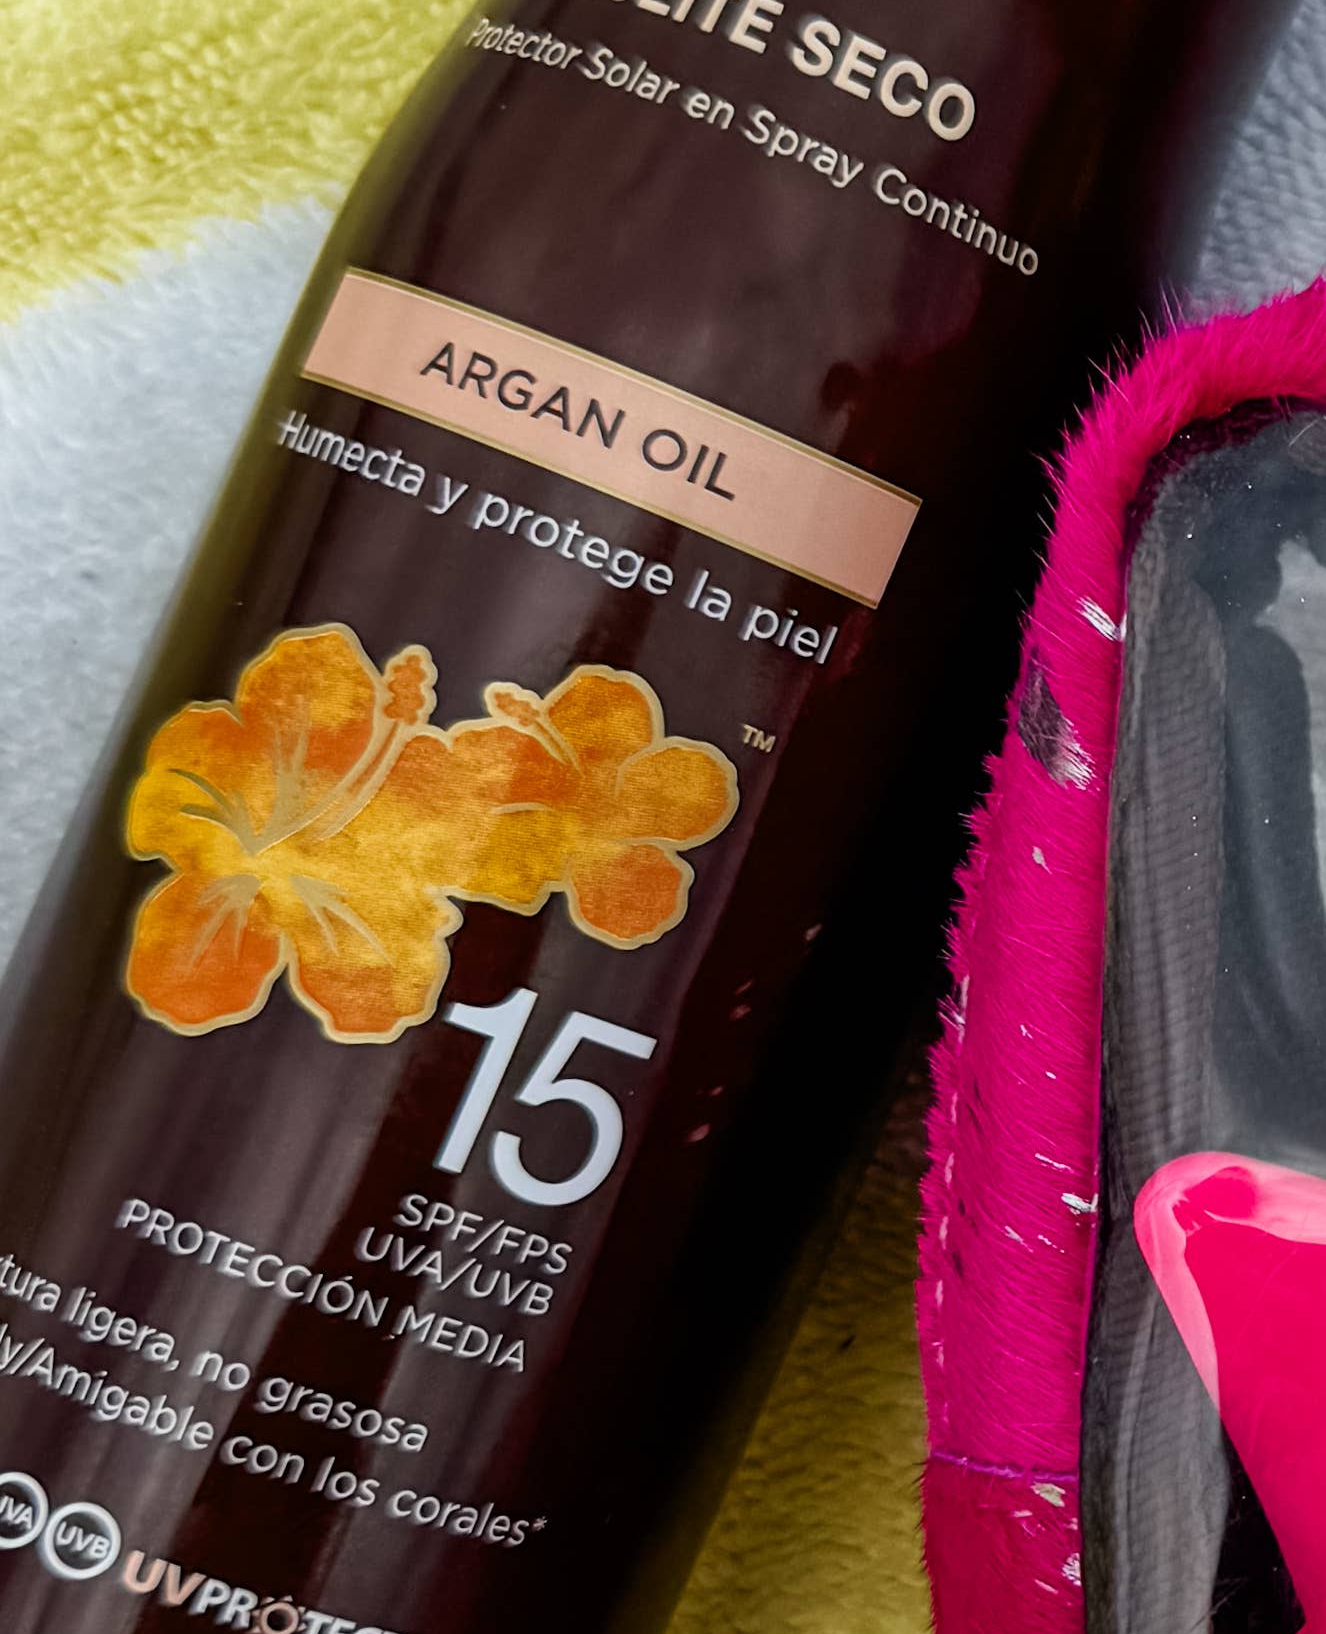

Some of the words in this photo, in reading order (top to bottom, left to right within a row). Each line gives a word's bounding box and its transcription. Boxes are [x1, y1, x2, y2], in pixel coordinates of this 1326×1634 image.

[465, 17, 583, 70] Protector
[578, 47, 681, 104] Solar
[685, 89, 736, 131] en
[744, 108, 864, 189] Spray
[874, 167, 1040, 276] Continuo
[790, 18, 976, 142] SECO
[419, 340, 627, 450] ARGAN
[641, 428, 736, 502] OIL
[276, 408, 425, 497] Humecta
[427, 478, 469, 515] y
[468, 492, 675, 590] protege
[685, 570, 733, 622] la
[739, 603, 838, 665] piel
[435, 987, 657, 1206] 15
[115, 1198, 389, 1328] PROTECCIÓN
[392, 1304, 526, 1374] MEDIA
[354, 1226, 554, 1316] UVA/UVB
[395, 1193, 573, 1275] SPF/FPS
[0, 1252, 62, 1313] tura
[61, 1285, 180, 1372] ligera,
[189, 1349, 251, 1392] no
[253, 1376, 429, 1453] grasosa
[55, 1520, 111, 1561] UVB
[221, 1435, 305, 1485] con
[309, 1455, 381, 1508] los
